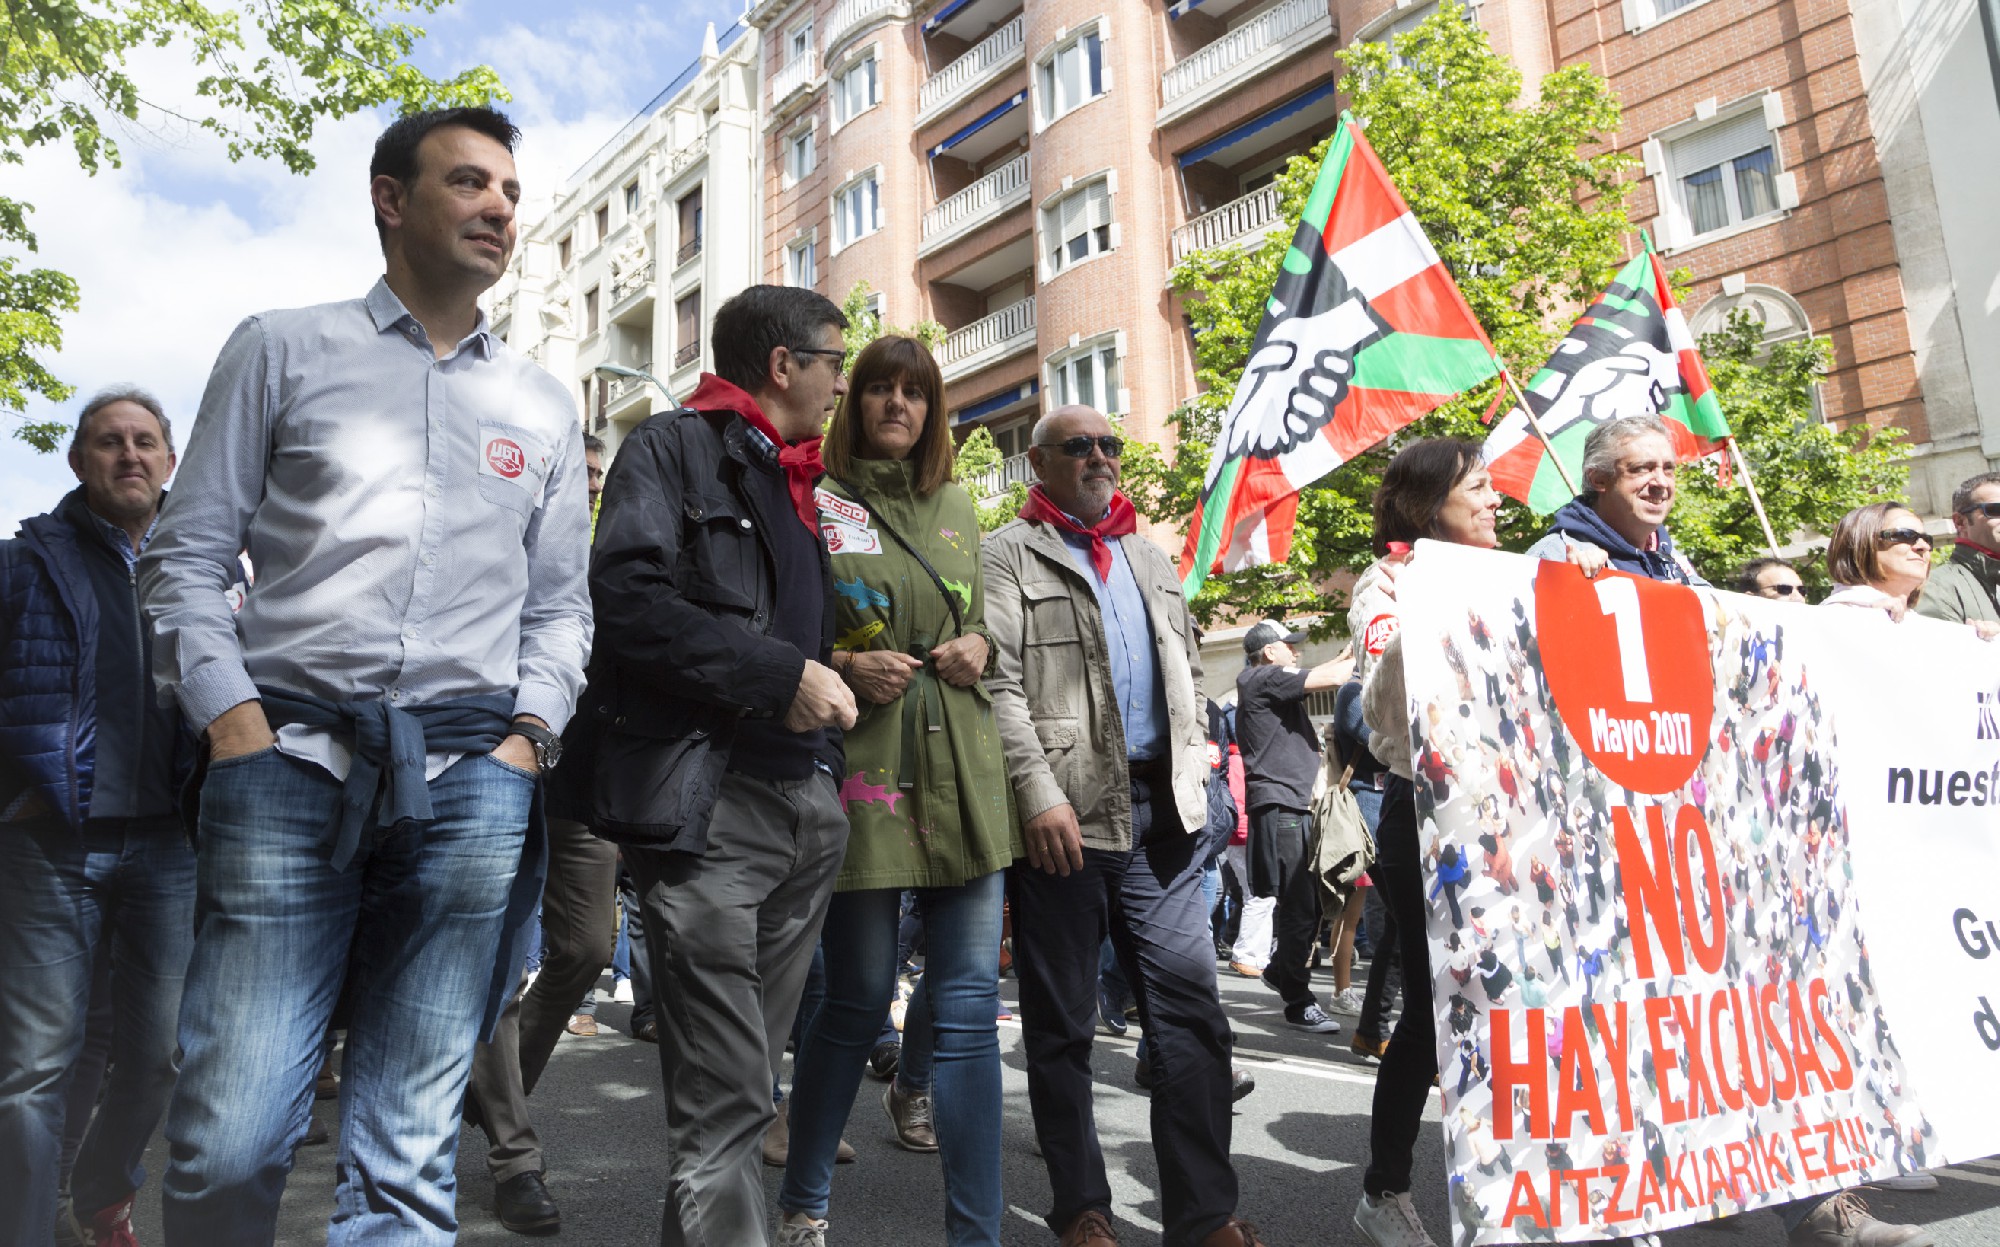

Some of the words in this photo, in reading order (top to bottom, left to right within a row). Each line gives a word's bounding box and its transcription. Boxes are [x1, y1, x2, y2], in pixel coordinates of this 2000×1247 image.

[490, 442, 520, 465] UGT
[818, 495, 864, 520] CCOO
[1594, 576, 1653, 703] 1
[1588, 708, 1649, 761] Mayo
[1651, 710, 1692, 755] 2017
[1888, 760, 2000, 807] nuest
[1611, 803, 1726, 979] NO
[1489, 1002, 1635, 1141] HAY
[1644, 978, 1855, 1126] EXCUSAS
[1502, 1132, 1796, 1229] AITZAKIARIK
[1799, 1116, 1877, 1181] EZ!!!
